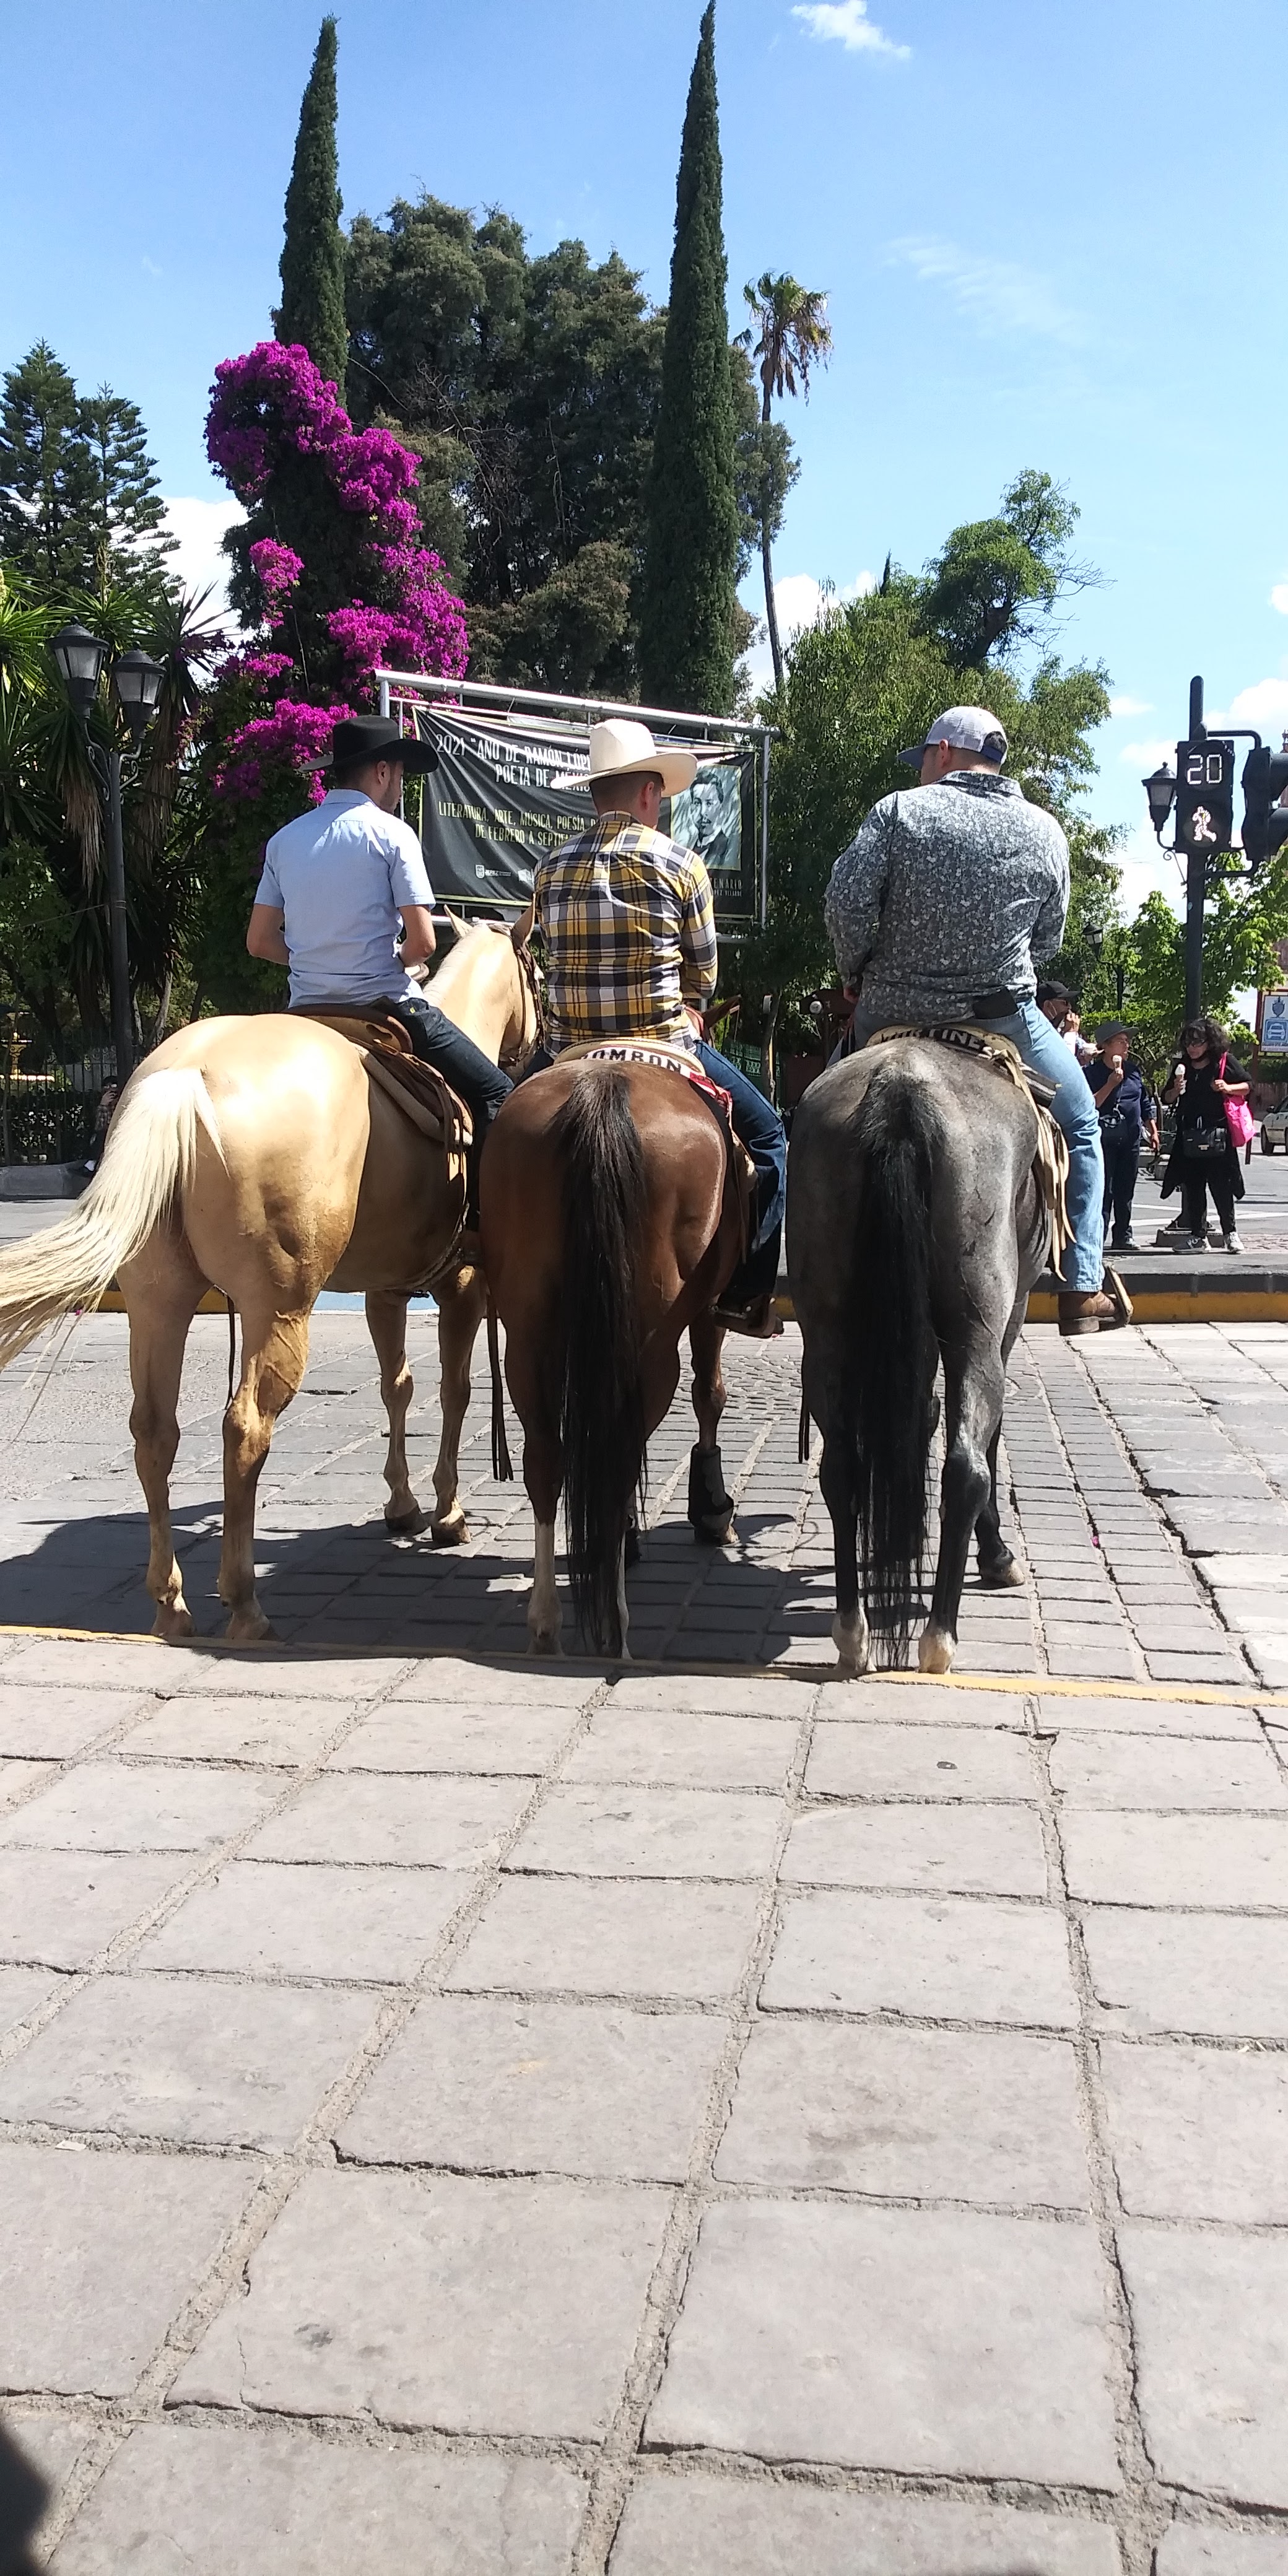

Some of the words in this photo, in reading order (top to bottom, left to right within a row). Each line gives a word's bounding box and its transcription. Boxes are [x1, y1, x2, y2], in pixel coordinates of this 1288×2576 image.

[436, 734, 464, 756] 2021
[505, 744, 520, 763] DE
[524, 745, 564, 768] RAMÓN
[495, 764, 531, 786] POETA
[535, 768, 551, 788] DE
[1187, 754, 1222, 785] 20
[475, 824, 487, 839] DE
[487, 826, 525, 844] FEBRERO
[528, 830, 535, 845] A
